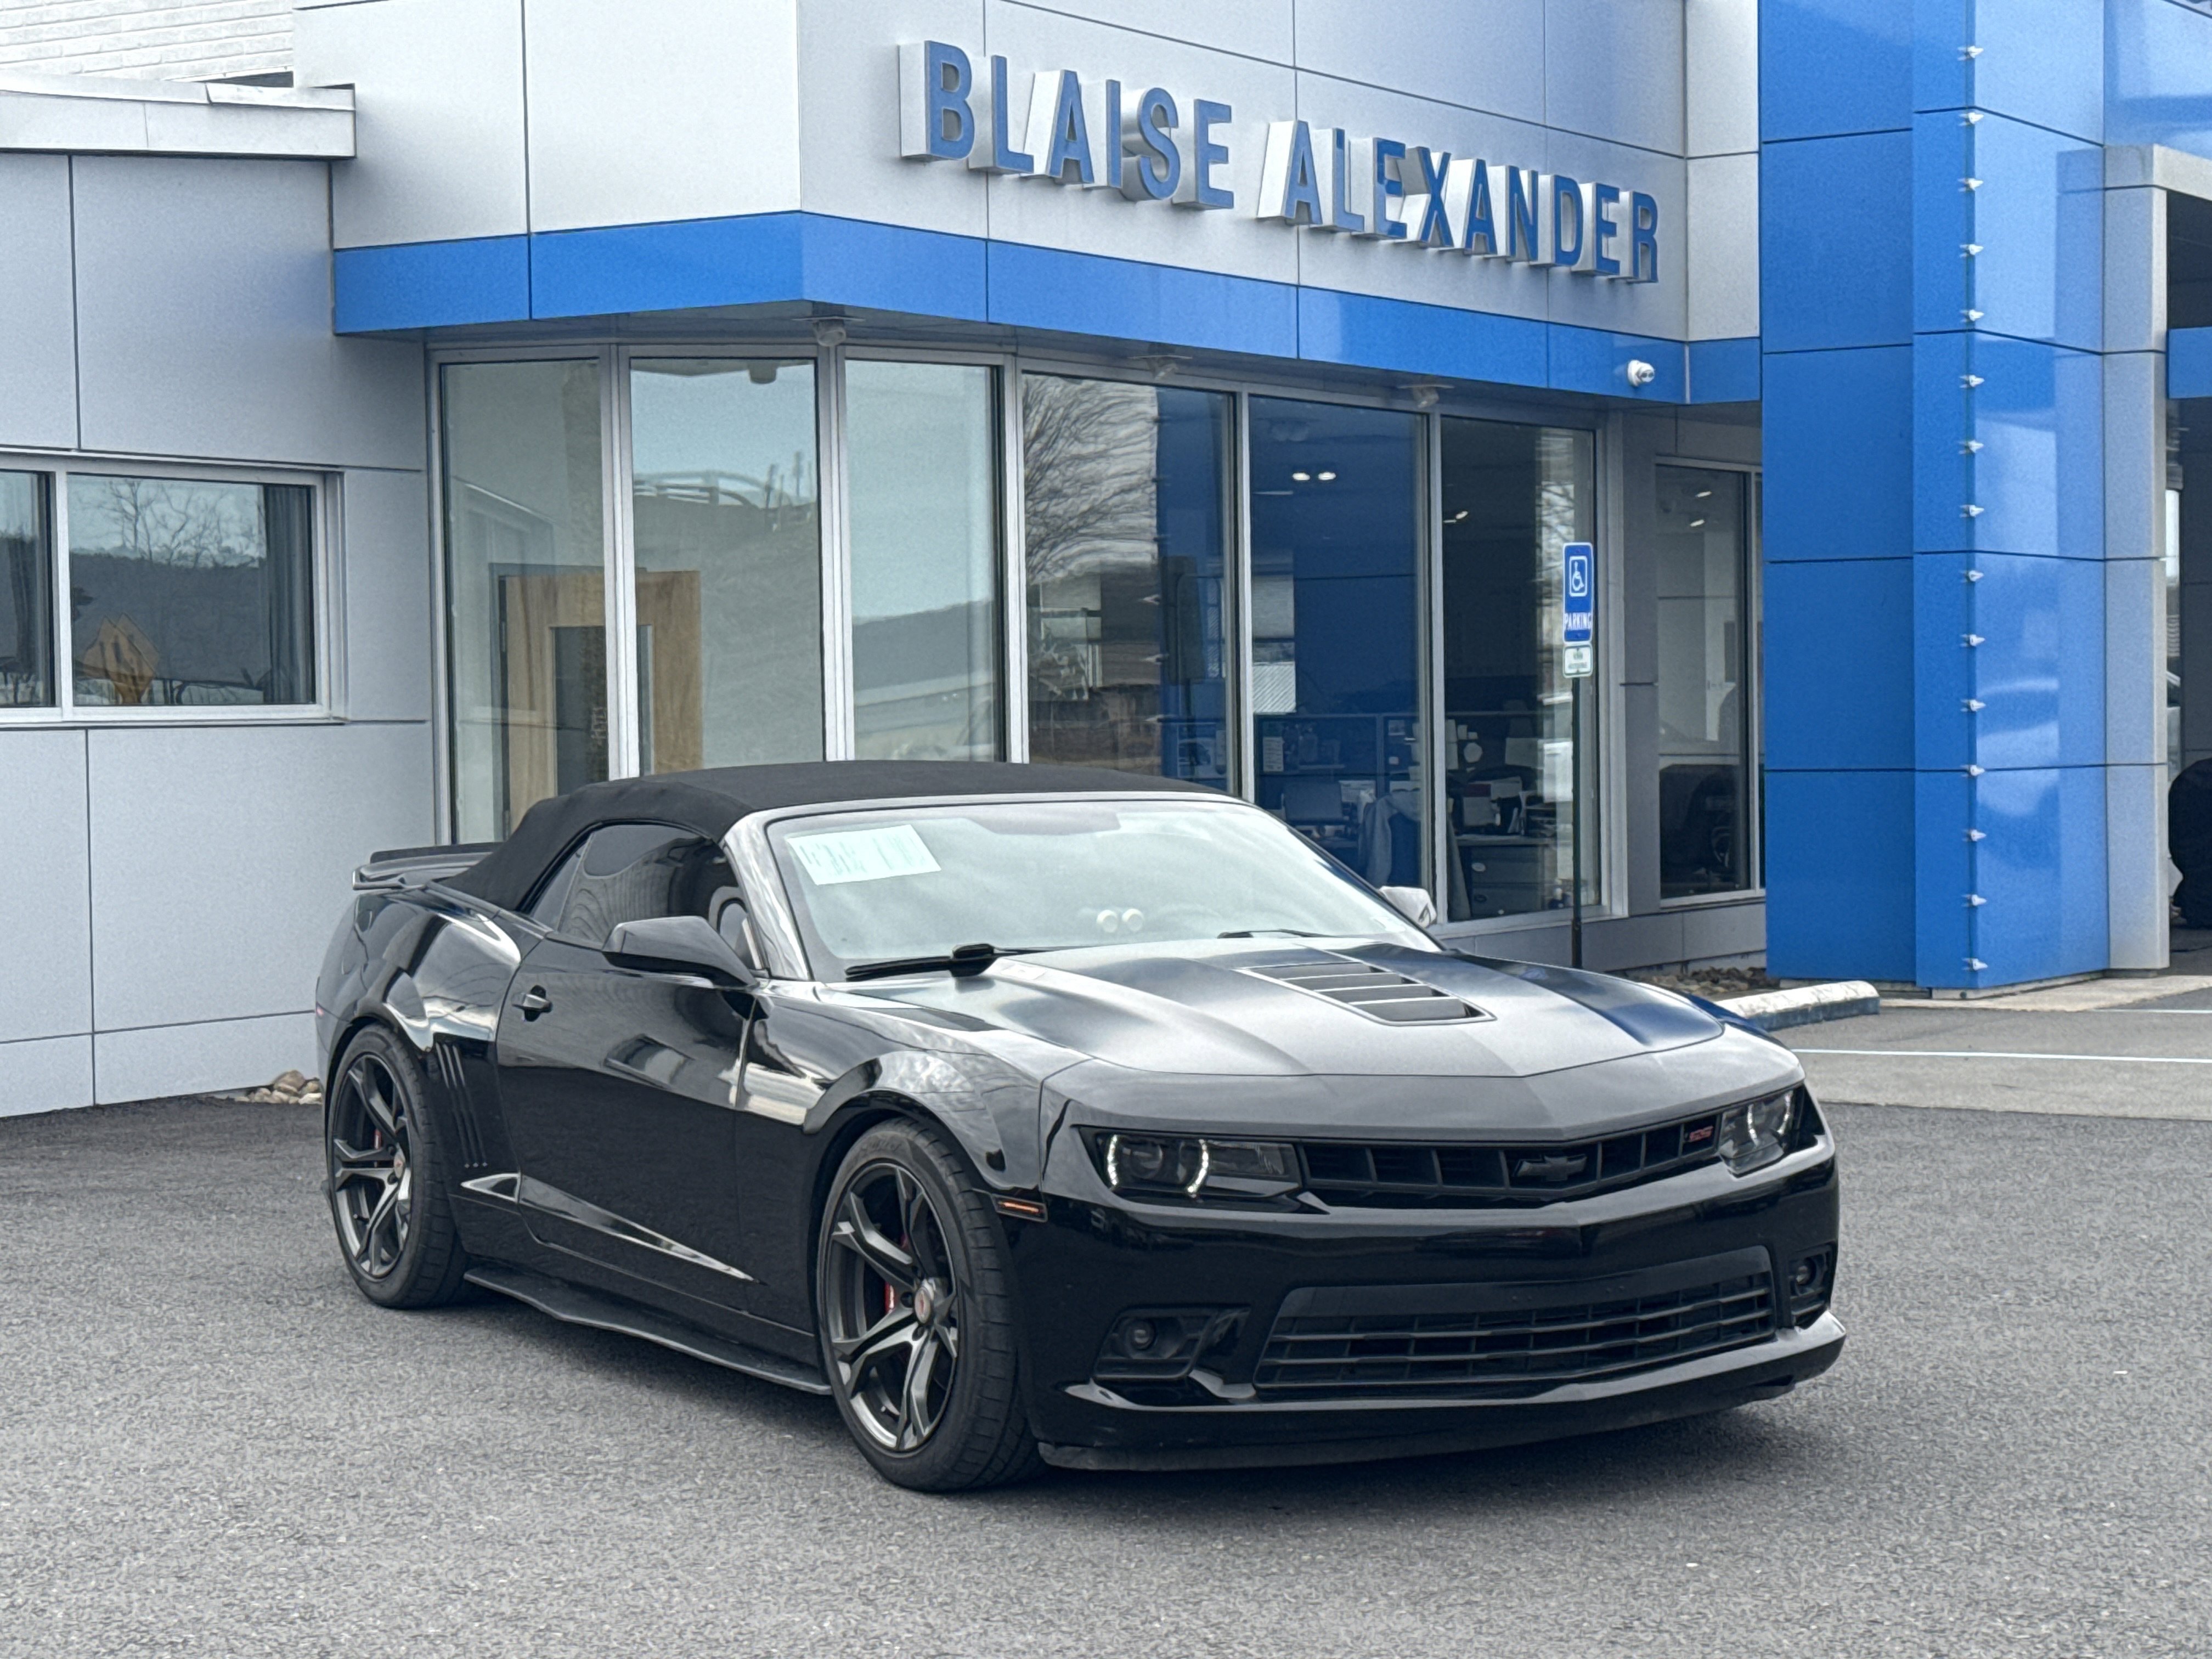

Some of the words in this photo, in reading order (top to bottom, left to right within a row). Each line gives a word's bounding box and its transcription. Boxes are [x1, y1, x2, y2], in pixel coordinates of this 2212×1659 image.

[923, 40, 1234, 210] BLAISE
[1281, 120, 1659, 284] ALEXANDER
[1564, 612, 1592, 630] PARKING
